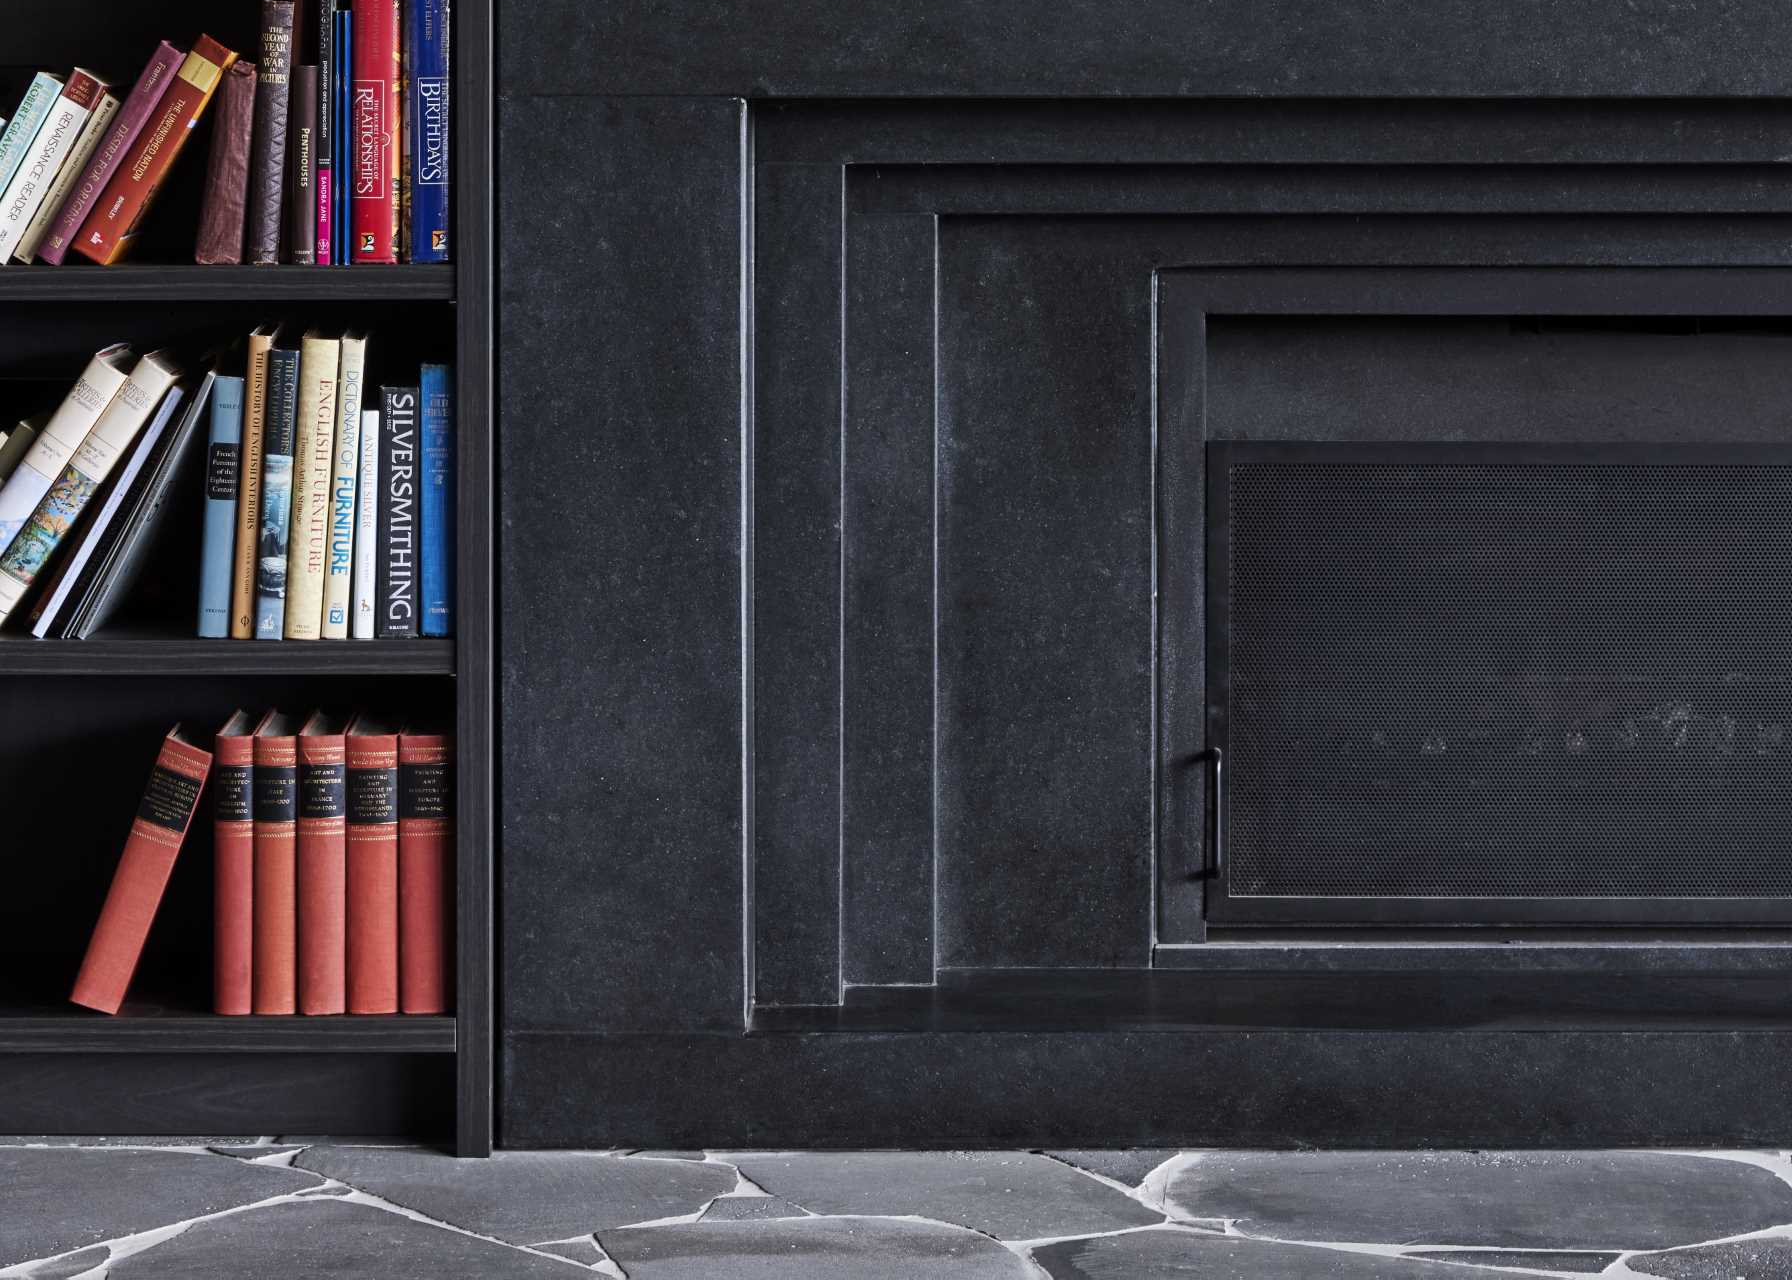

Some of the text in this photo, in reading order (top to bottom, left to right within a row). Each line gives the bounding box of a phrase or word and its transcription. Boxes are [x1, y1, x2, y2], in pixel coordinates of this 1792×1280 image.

[263, 57, 285, 67] WAR
[264, 43, 287, 52] YEAR
[299, 127, 311, 187] PENTHOUSES
[355, 87, 374, 194] RELATIONSHIPS
[246, 350, 265, 529] THE HISTORY OF ENGLISH INTERIORS
[308, 376, 333, 572] ENGLISH FURNITURE
[388, 391, 414, 619] SILVERSMITHING
